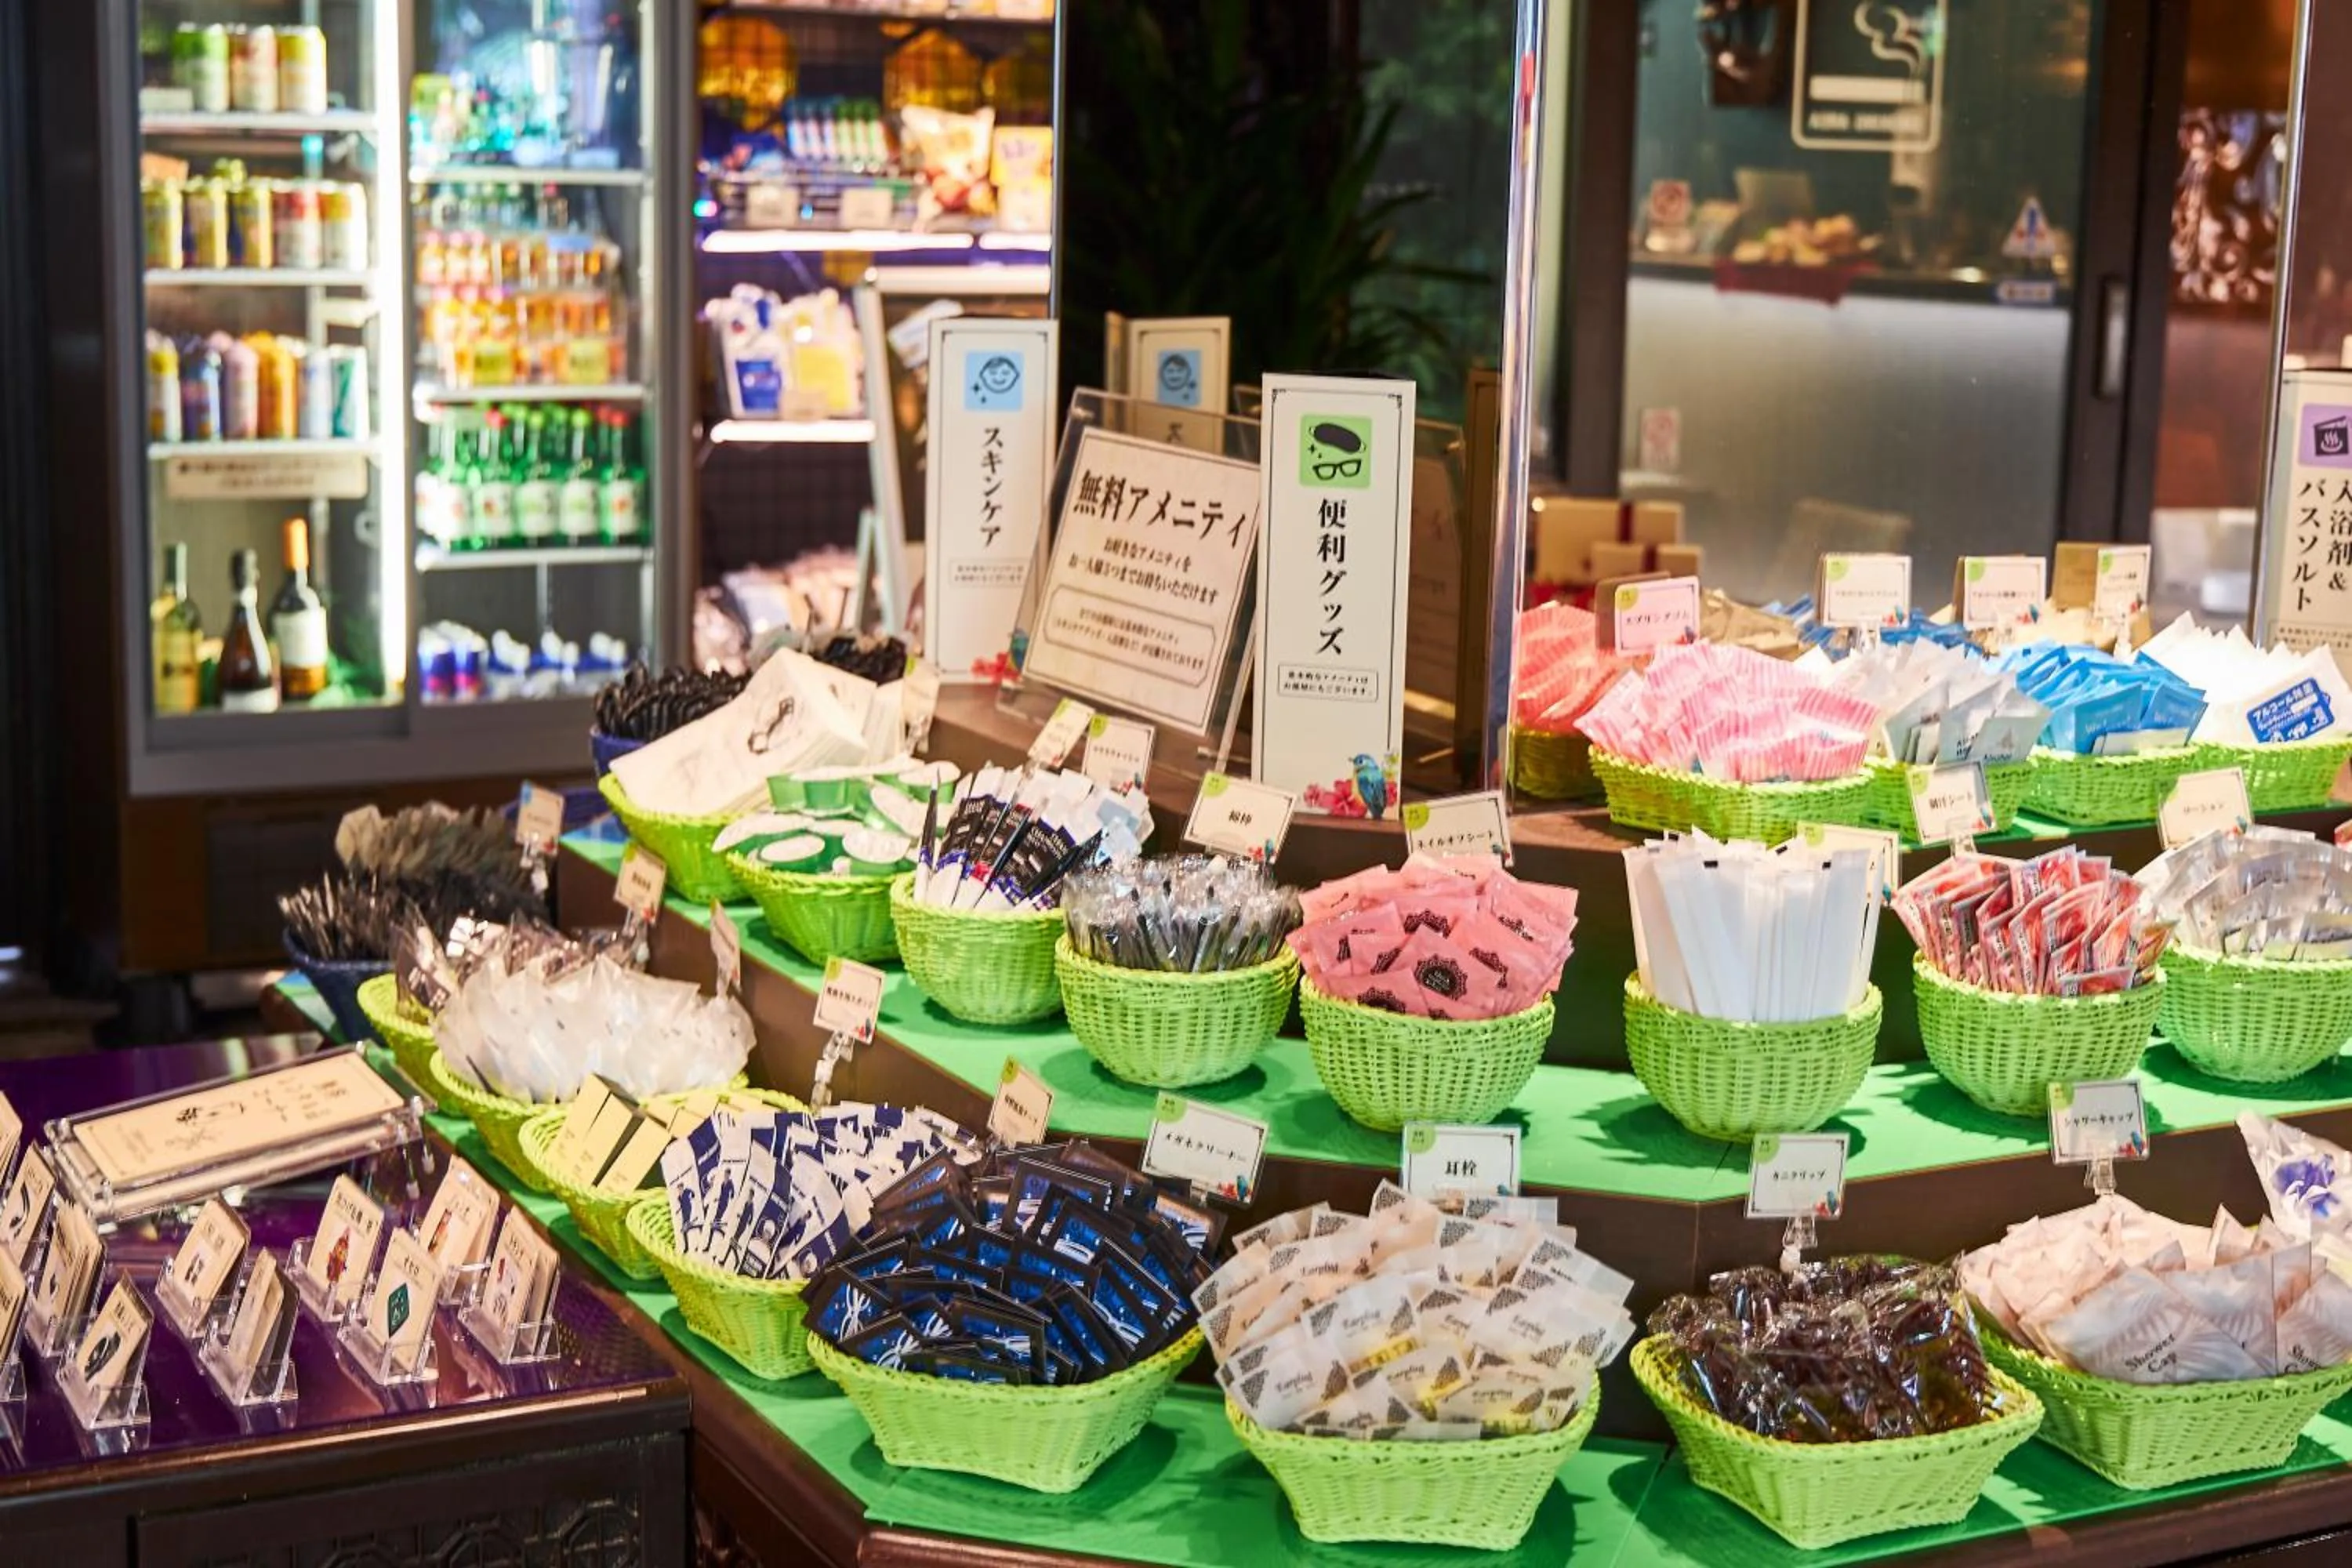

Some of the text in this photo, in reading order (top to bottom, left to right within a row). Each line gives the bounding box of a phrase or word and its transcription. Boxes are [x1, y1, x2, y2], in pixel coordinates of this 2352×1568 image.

[980, 426, 1004, 548] スキンケア
[1073, 469, 1247, 549] 無料アメニティ
[2292, 477, 2326, 612] バスソルト
[1316, 497, 1348, 655] 便利グッズ
[2064, 1112, 2134, 1127] シャワーキャップ
[1166, 1131, 1247, 1162] メガネクリーナー
[1444, 1160, 1477, 1177] 耳栓
[2124, 1333, 2176, 1372] Shower
[2147, 1352, 2178, 1375] Cap
